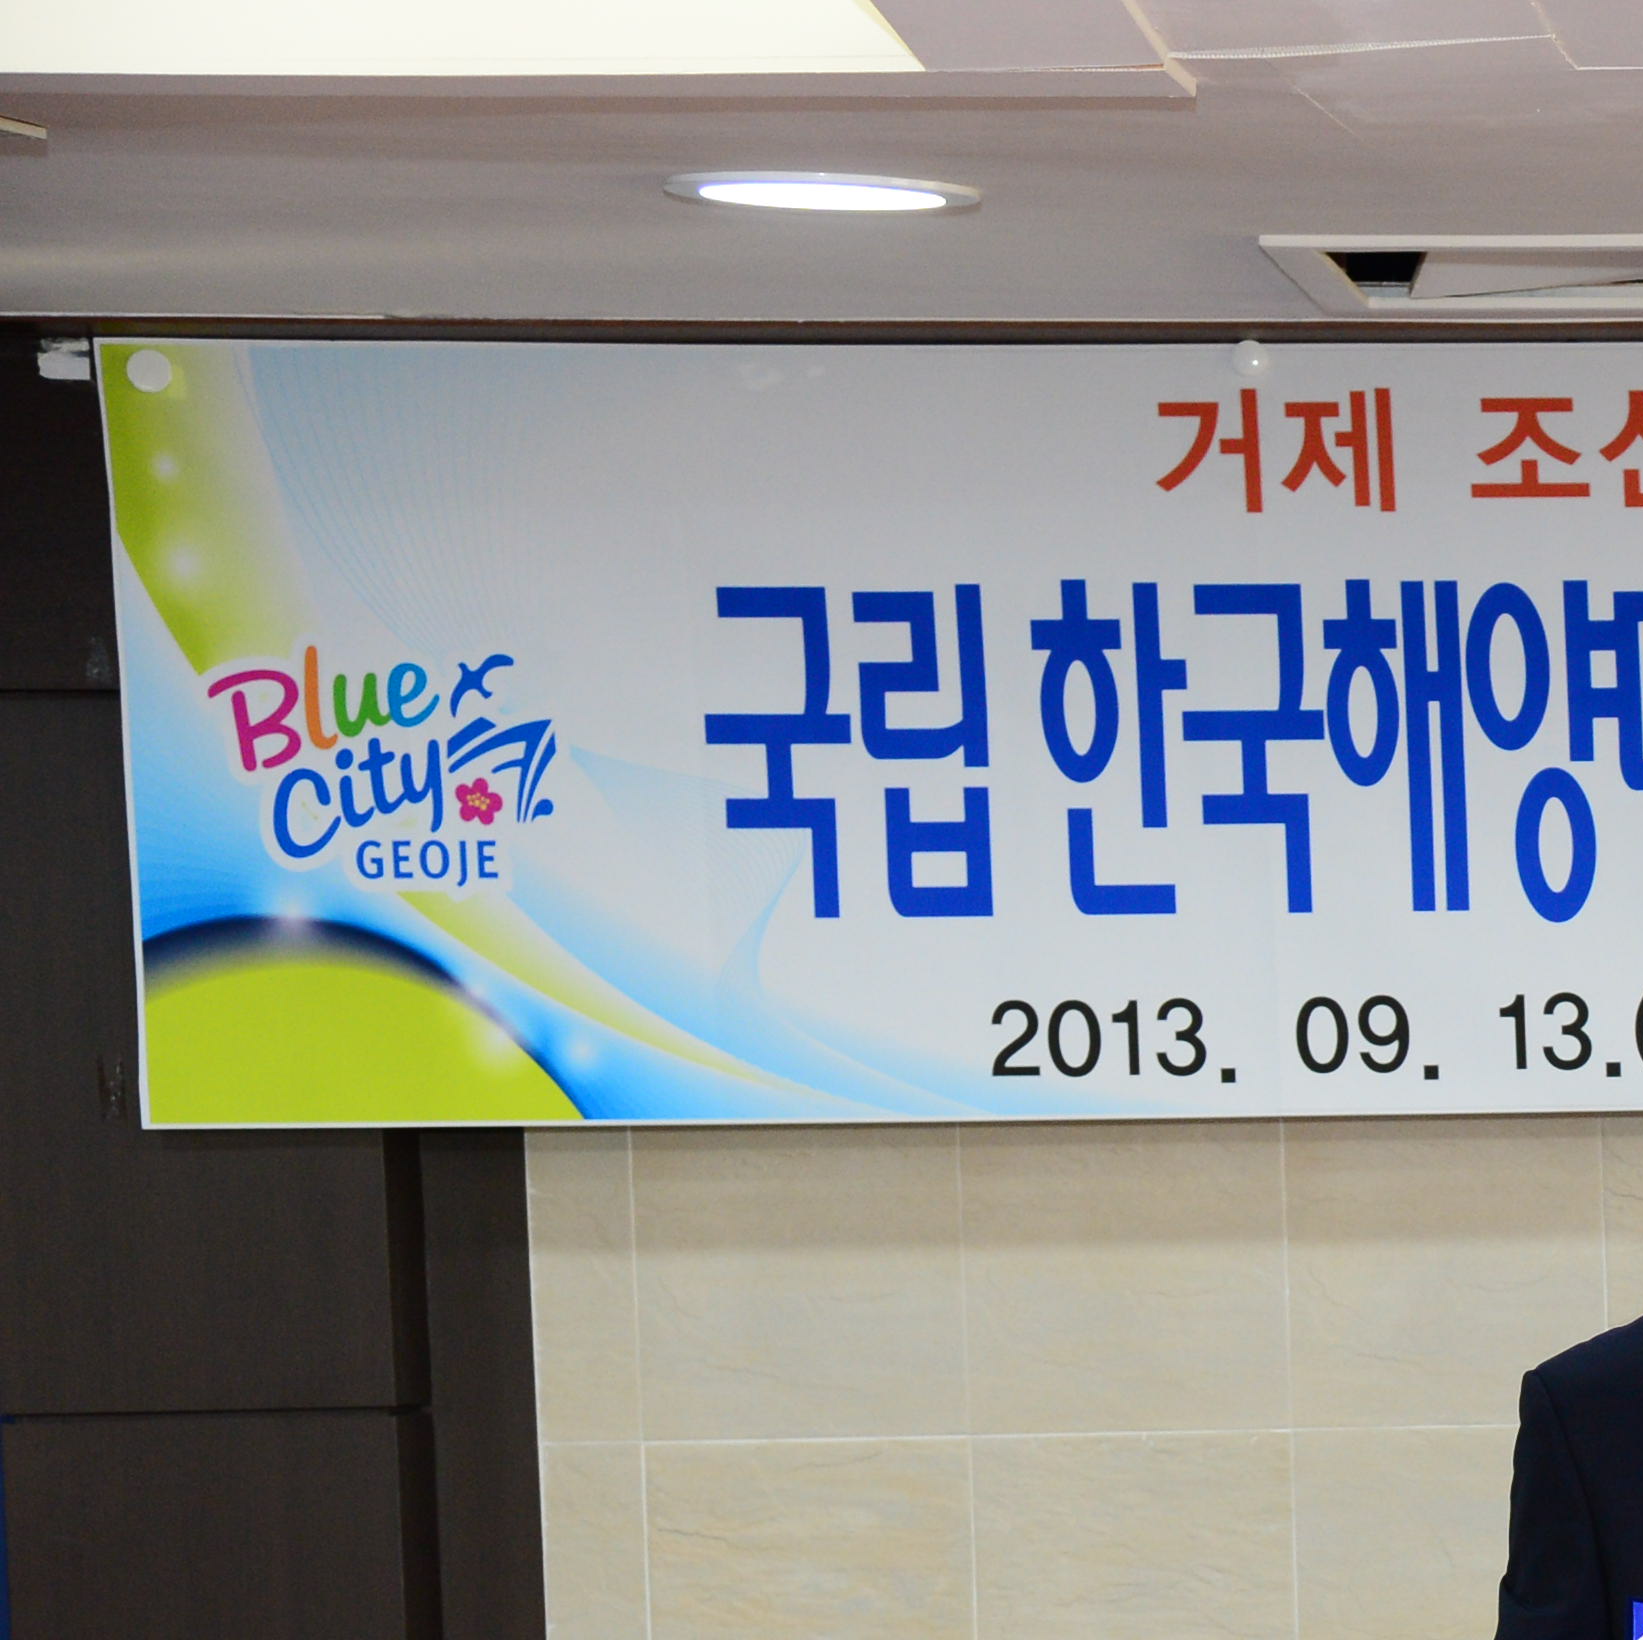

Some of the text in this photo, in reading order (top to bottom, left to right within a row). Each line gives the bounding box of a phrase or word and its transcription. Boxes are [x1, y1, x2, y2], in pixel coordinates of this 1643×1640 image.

[1157, 387, 1398, 514] 거제
[207, 645, 440, 772] Blue
[703, 582, 995, 920] 국립
[273, 737, 443, 858] City
[355, 839, 500, 888] GEOJE
[991, 998, 1237, 1083] 2013.
[1295, 995, 1440, 1081] 09.
